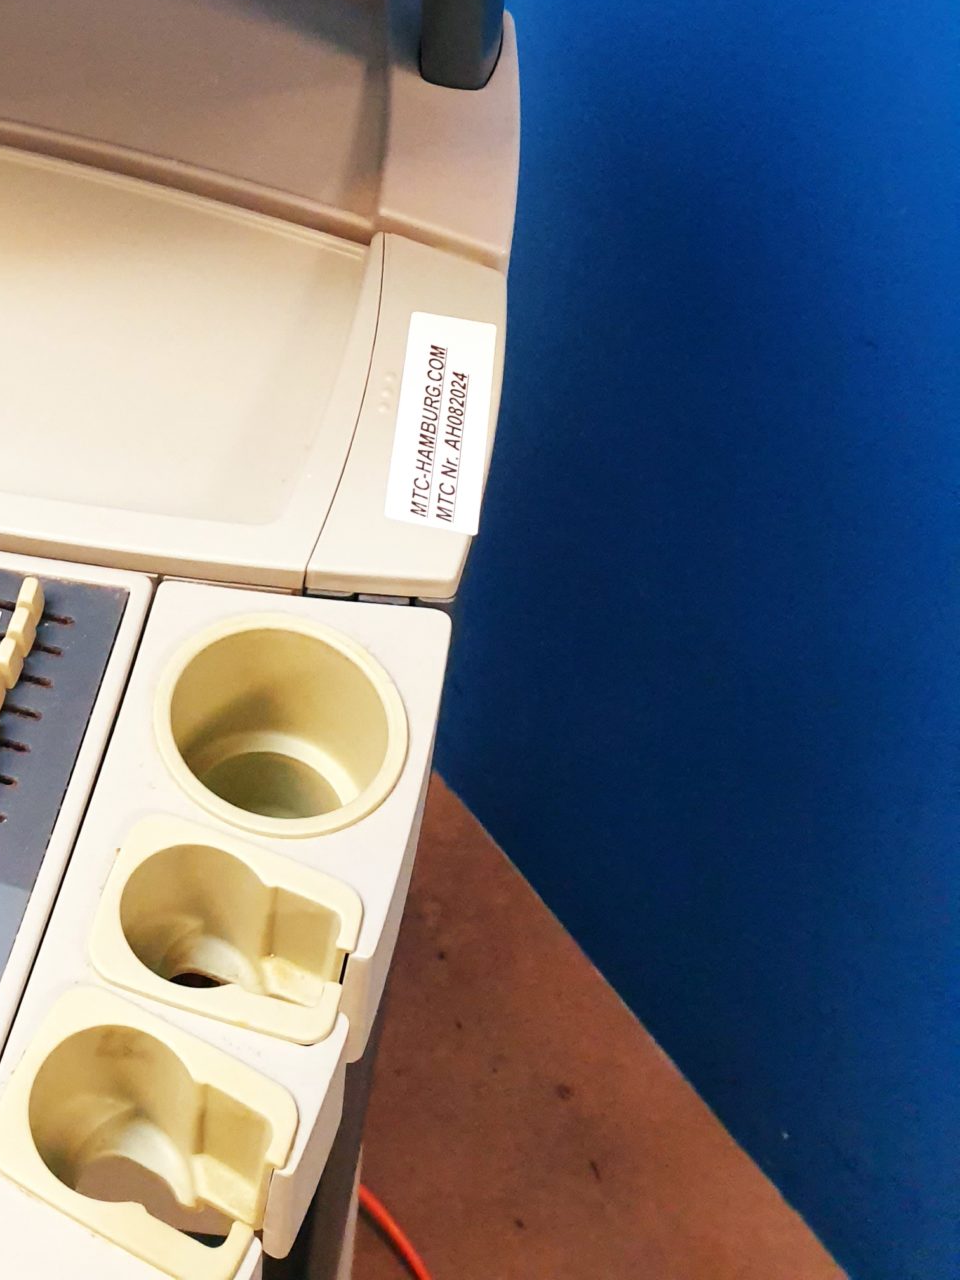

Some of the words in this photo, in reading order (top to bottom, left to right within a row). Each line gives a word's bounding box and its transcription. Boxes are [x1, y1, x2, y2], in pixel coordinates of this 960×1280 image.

[410, 344, 447, 518] MTC-HAMBURG.COM
[444, 372, 468, 451] AH082024
[436, 482, 455, 522] MTC
